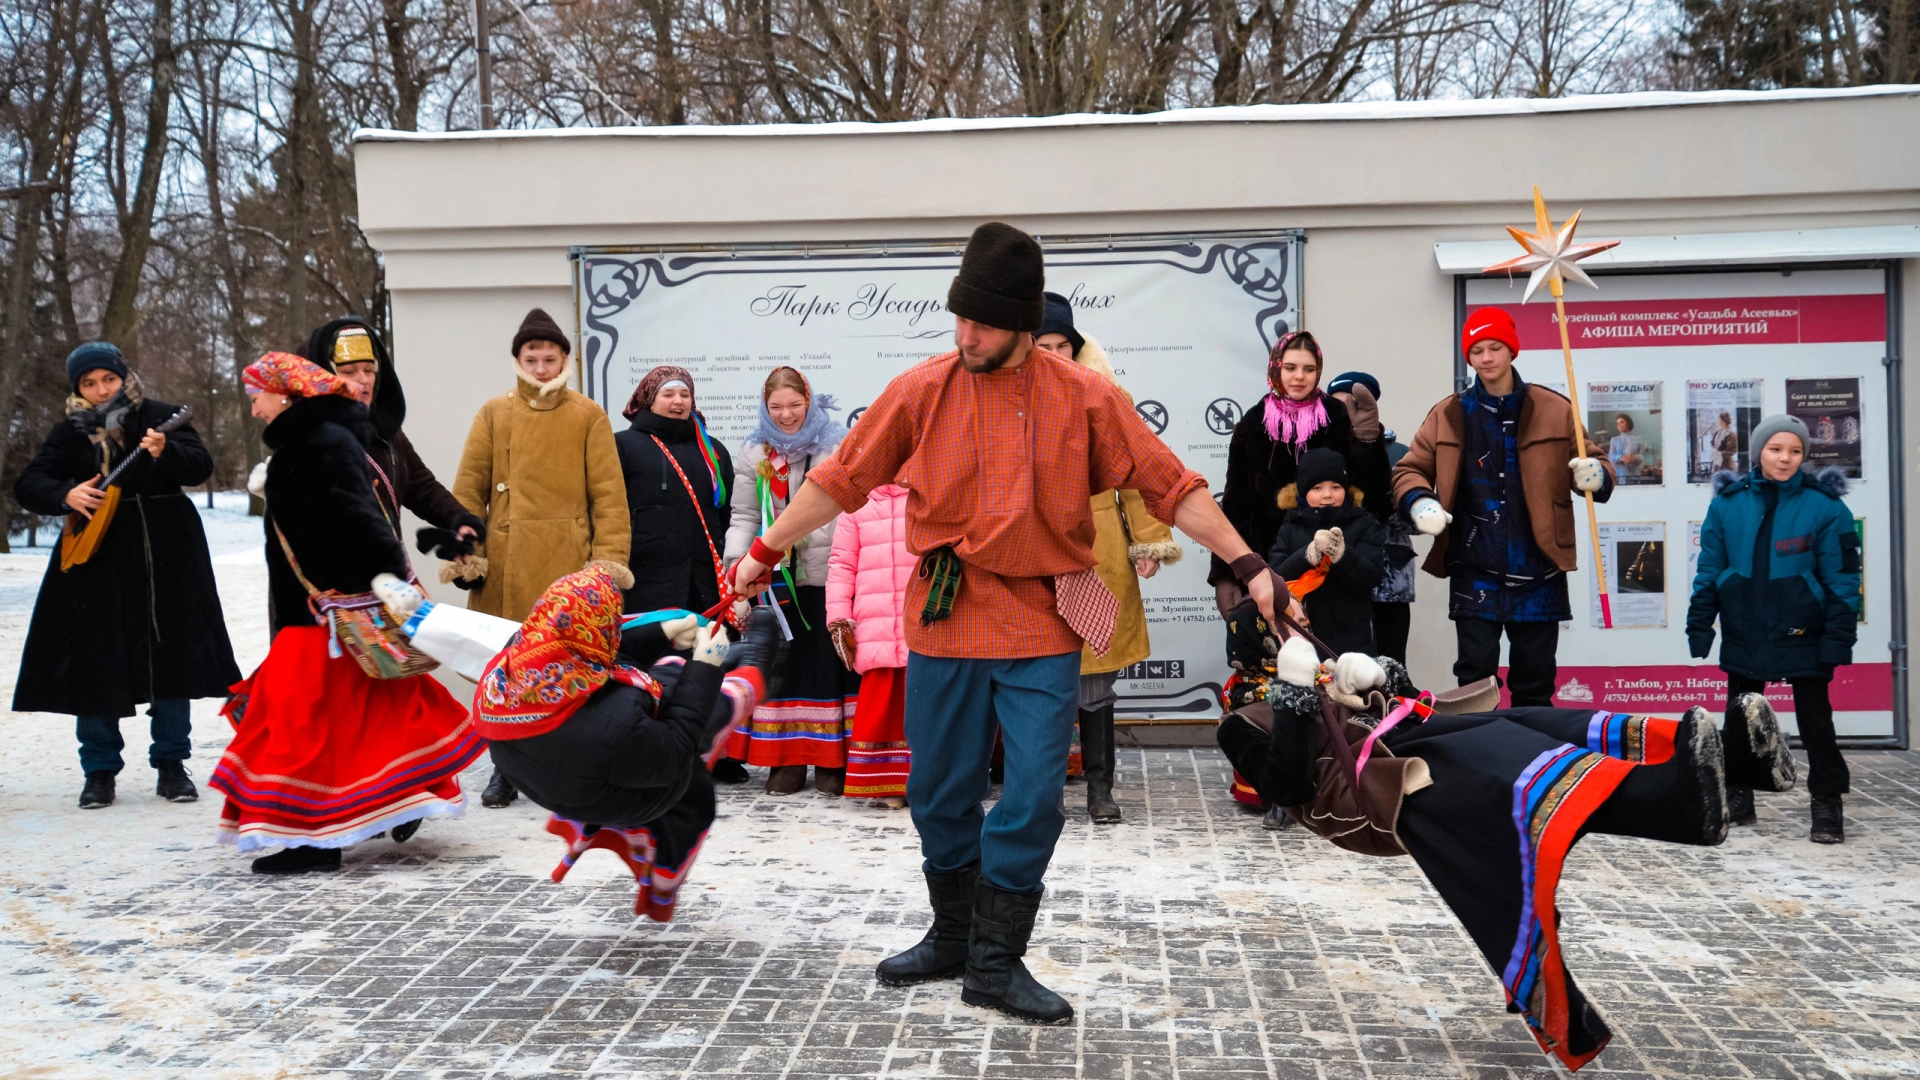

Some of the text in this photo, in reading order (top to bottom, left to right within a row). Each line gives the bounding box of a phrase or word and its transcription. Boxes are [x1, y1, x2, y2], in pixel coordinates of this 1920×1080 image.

[750, 284, 841, 327] Парк
[1551, 306, 1799, 325] Музейный комплекс «Усадьба Асеевых»
[1581, 319, 1769, 339] АФИША МЕРОПРИЯТИЙ
[1108, 345, 1159, 355] федерального
[715, 353, 750, 363] музейный
[1590, 384, 1655, 394] PRO УСАДЬБУ
[1689, 381, 1754, 391] PRO УСАДЬБУ
[1188, 443, 1224, 452] распивать
[1152, 596, 1198, 604] экстренных
[1162, 605, 1204, 614] Музейного
[1183, 615, 1206, 623] (4752)
[1129, 682, 1165, 690] MK-ASEEVA
[1604, 681, 1614, 689] г.
[1616, 678, 1663, 691] Тамбов,
[1665, 679, 1684, 691] ул.
[1686, 677, 1728, 691] Набере
[1603, 692, 1631, 703] /4752/
[1631, 692, 1670, 703] 63-64-69,
[1671, 692, 1708, 702] 63-64-71
